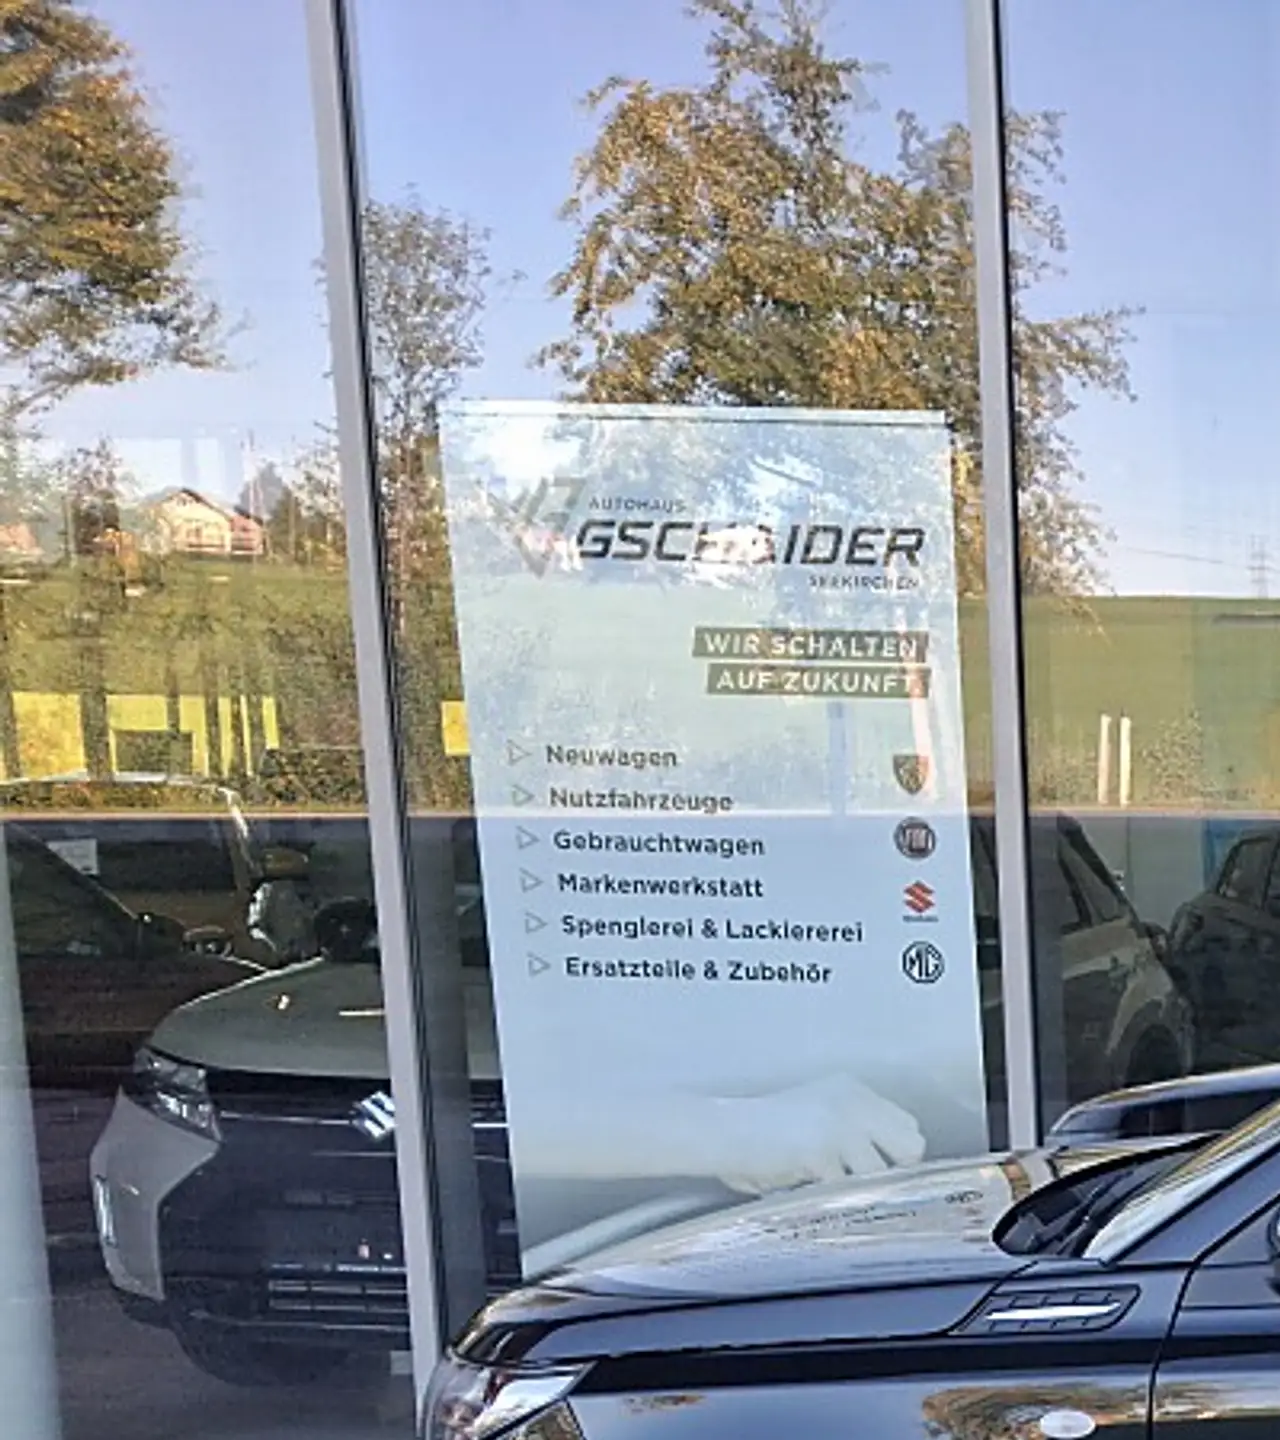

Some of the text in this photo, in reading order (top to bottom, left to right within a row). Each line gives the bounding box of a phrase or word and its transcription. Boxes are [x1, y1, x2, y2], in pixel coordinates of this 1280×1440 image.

[703, 633, 917, 658] WIR SCHALTEN
[715, 669, 773, 690] AUF
[546, 746, 678, 769] Neuwagen
[549, 787, 734, 814] Nutzfahrzeuge
[552, 829, 766, 859] Gebrauchtwagen
[557, 873, 764, 898] Markenwerkstatt
[561, 914, 864, 943] Spenglerei & Lackiererei
[565, 956, 833, 984] Ersatzteile & Zubehör
